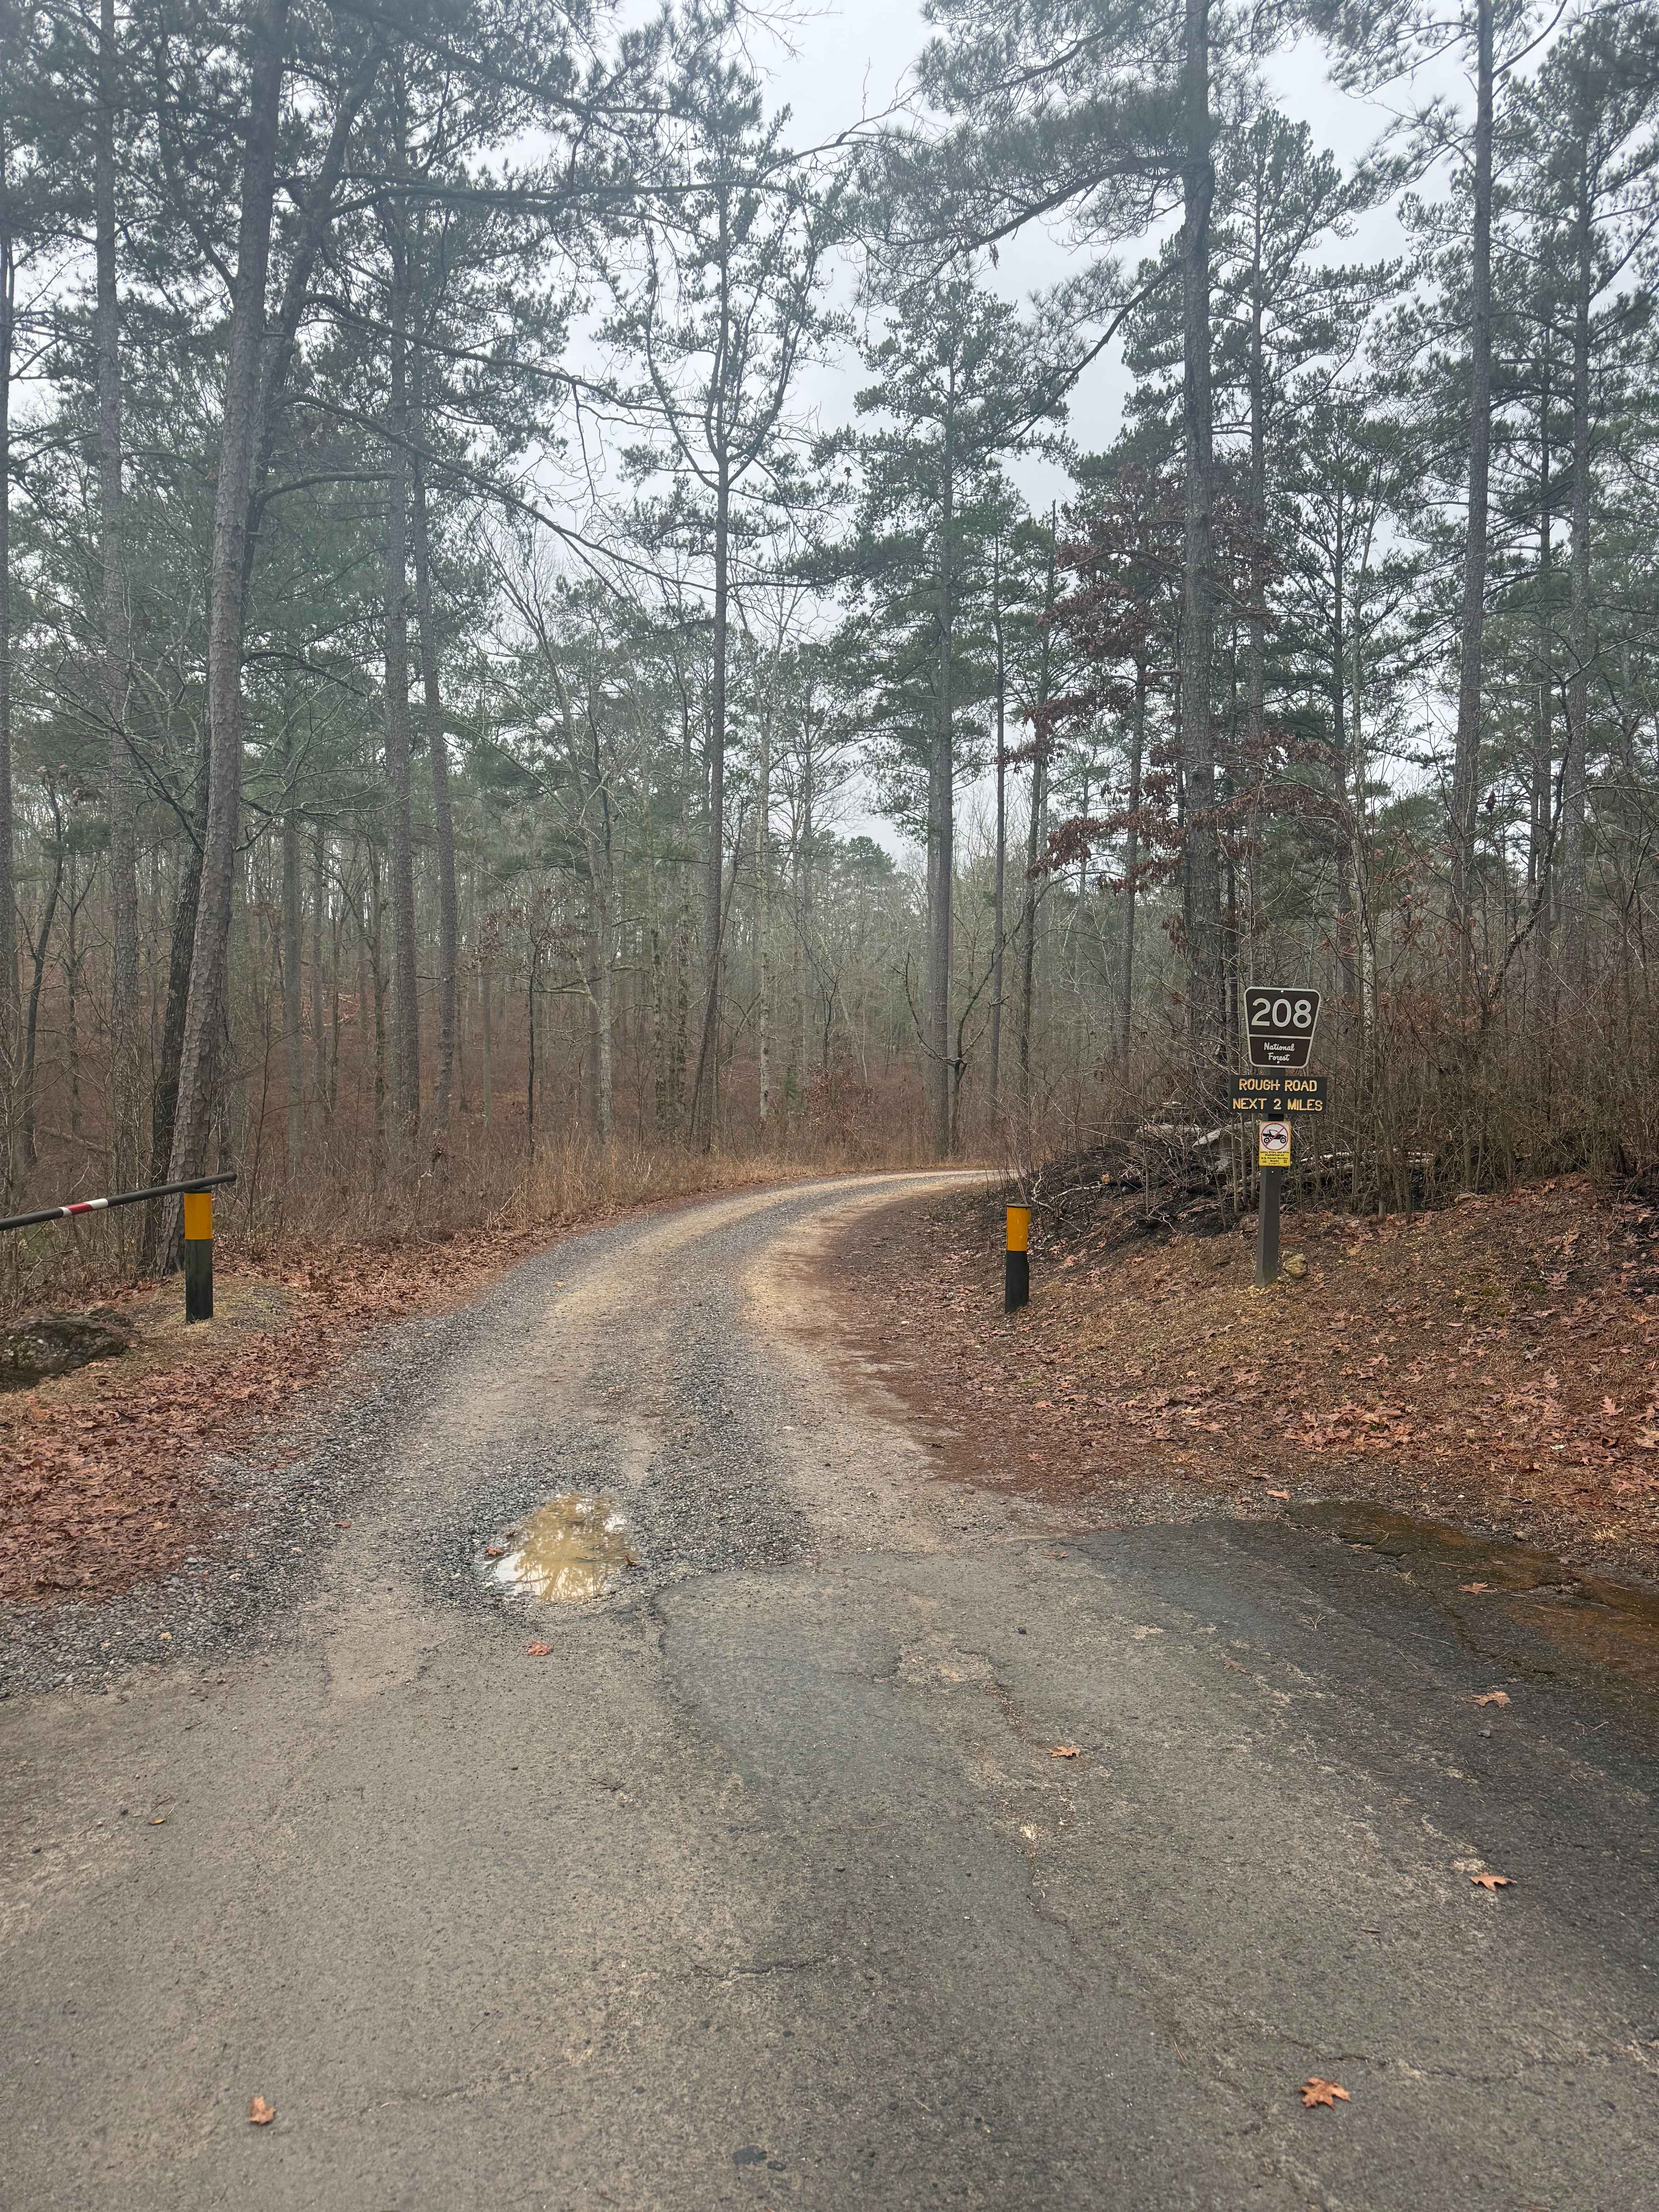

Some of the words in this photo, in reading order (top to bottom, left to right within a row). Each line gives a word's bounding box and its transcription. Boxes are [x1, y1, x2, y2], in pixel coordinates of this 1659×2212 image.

[1251, 998, 1312, 1028] 208
[1264, 1042, 1295, 1051] National
[1268, 1053, 1290, 1061] Forest
[1239, 1078, 1279, 1091] ROUGH
[1285, 1080, 1317, 1092] ROAD
[1233, 1097, 1267, 1109] NEXT
[1273, 1098, 1281, 1109] 2
[1287, 1098, 1323, 1111] MILES
